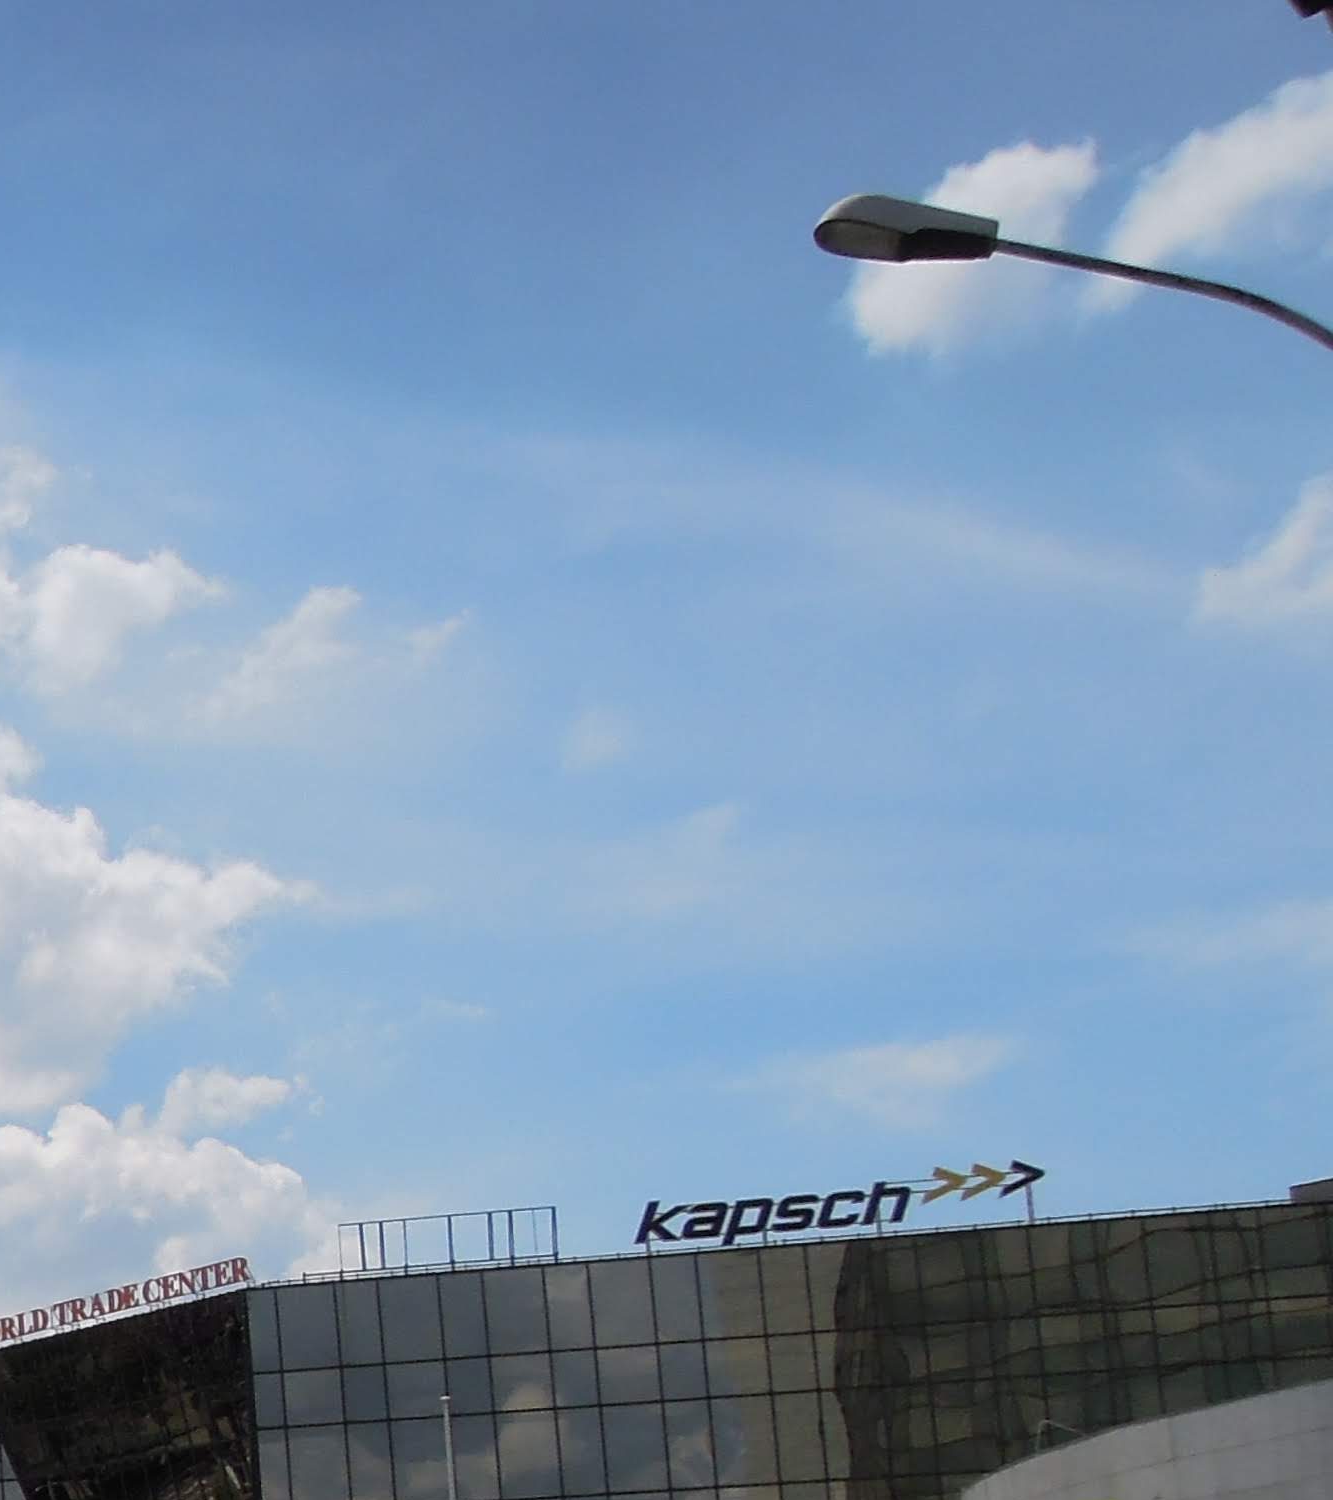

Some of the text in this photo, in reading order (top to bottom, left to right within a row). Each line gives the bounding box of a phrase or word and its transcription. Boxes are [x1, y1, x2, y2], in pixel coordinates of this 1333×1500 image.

[634, 1180, 912, 1247] kapsch
[54, 1283, 140, 1325] TRADE
[142, 1256, 251, 1303] CENTER
